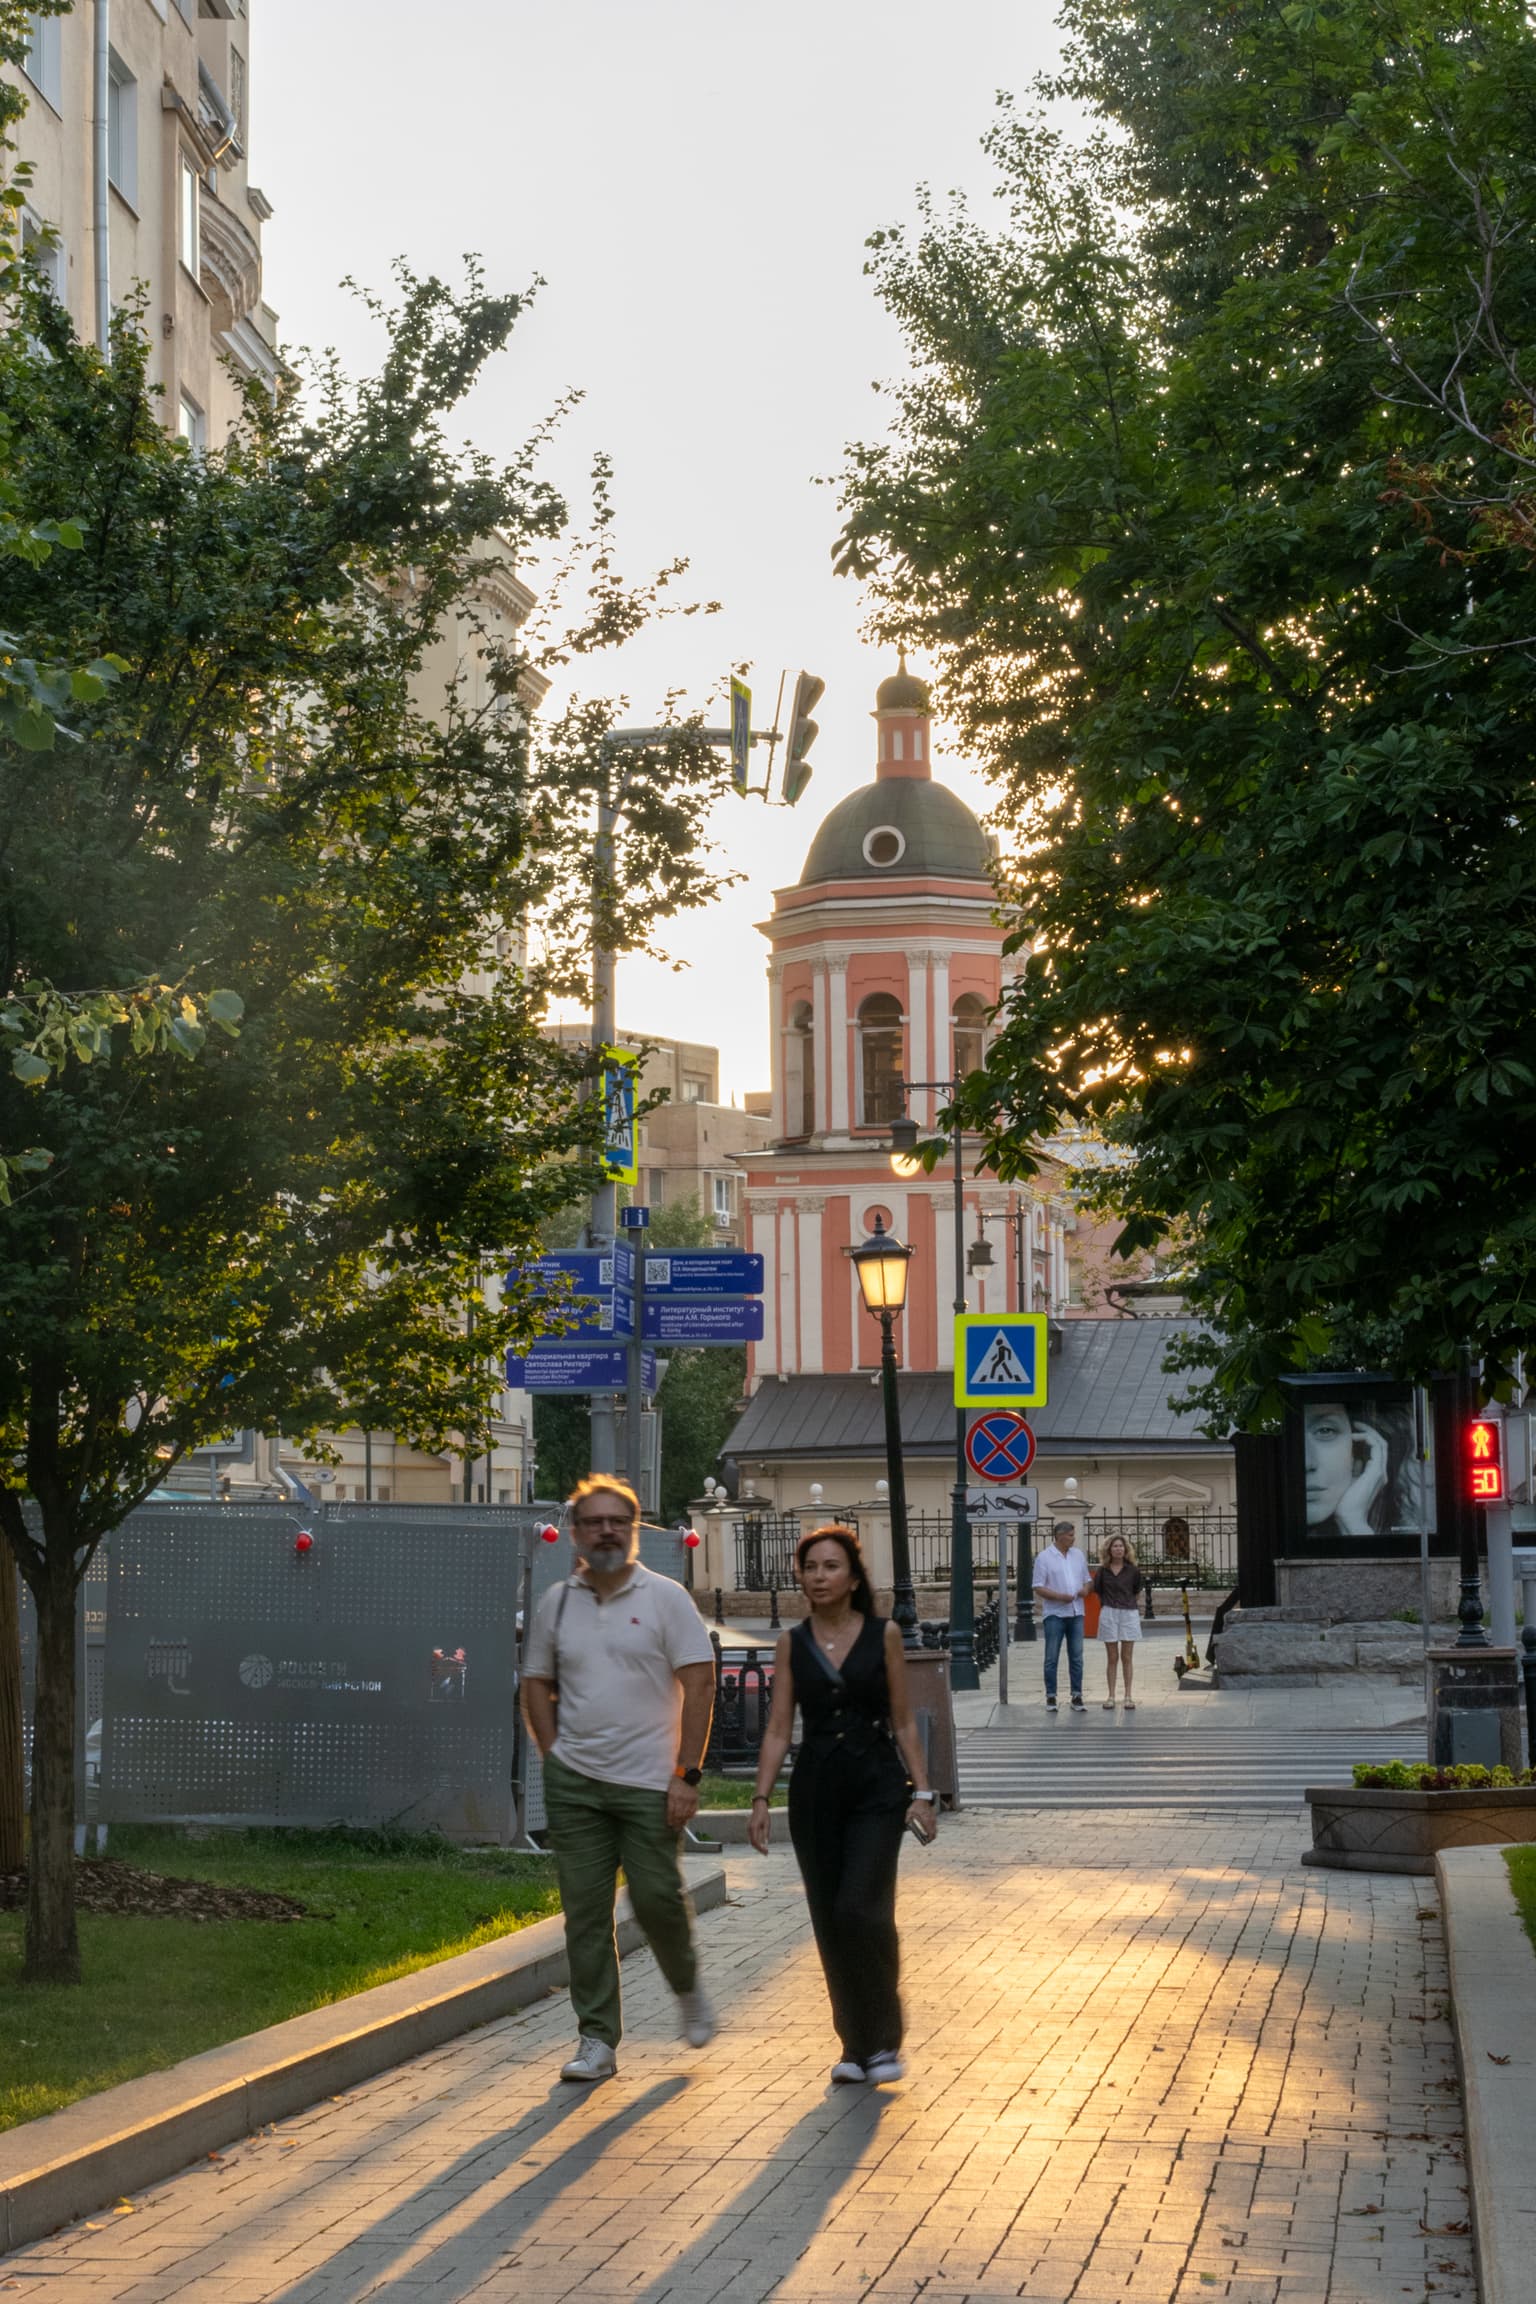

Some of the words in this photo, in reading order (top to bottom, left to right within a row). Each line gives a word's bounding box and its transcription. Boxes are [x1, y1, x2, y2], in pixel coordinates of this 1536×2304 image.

[660, 1305, 712, 1314] Литературный
[713, 1305, 744, 1315] институт
[700, 1314, 731, 1322] Горького
